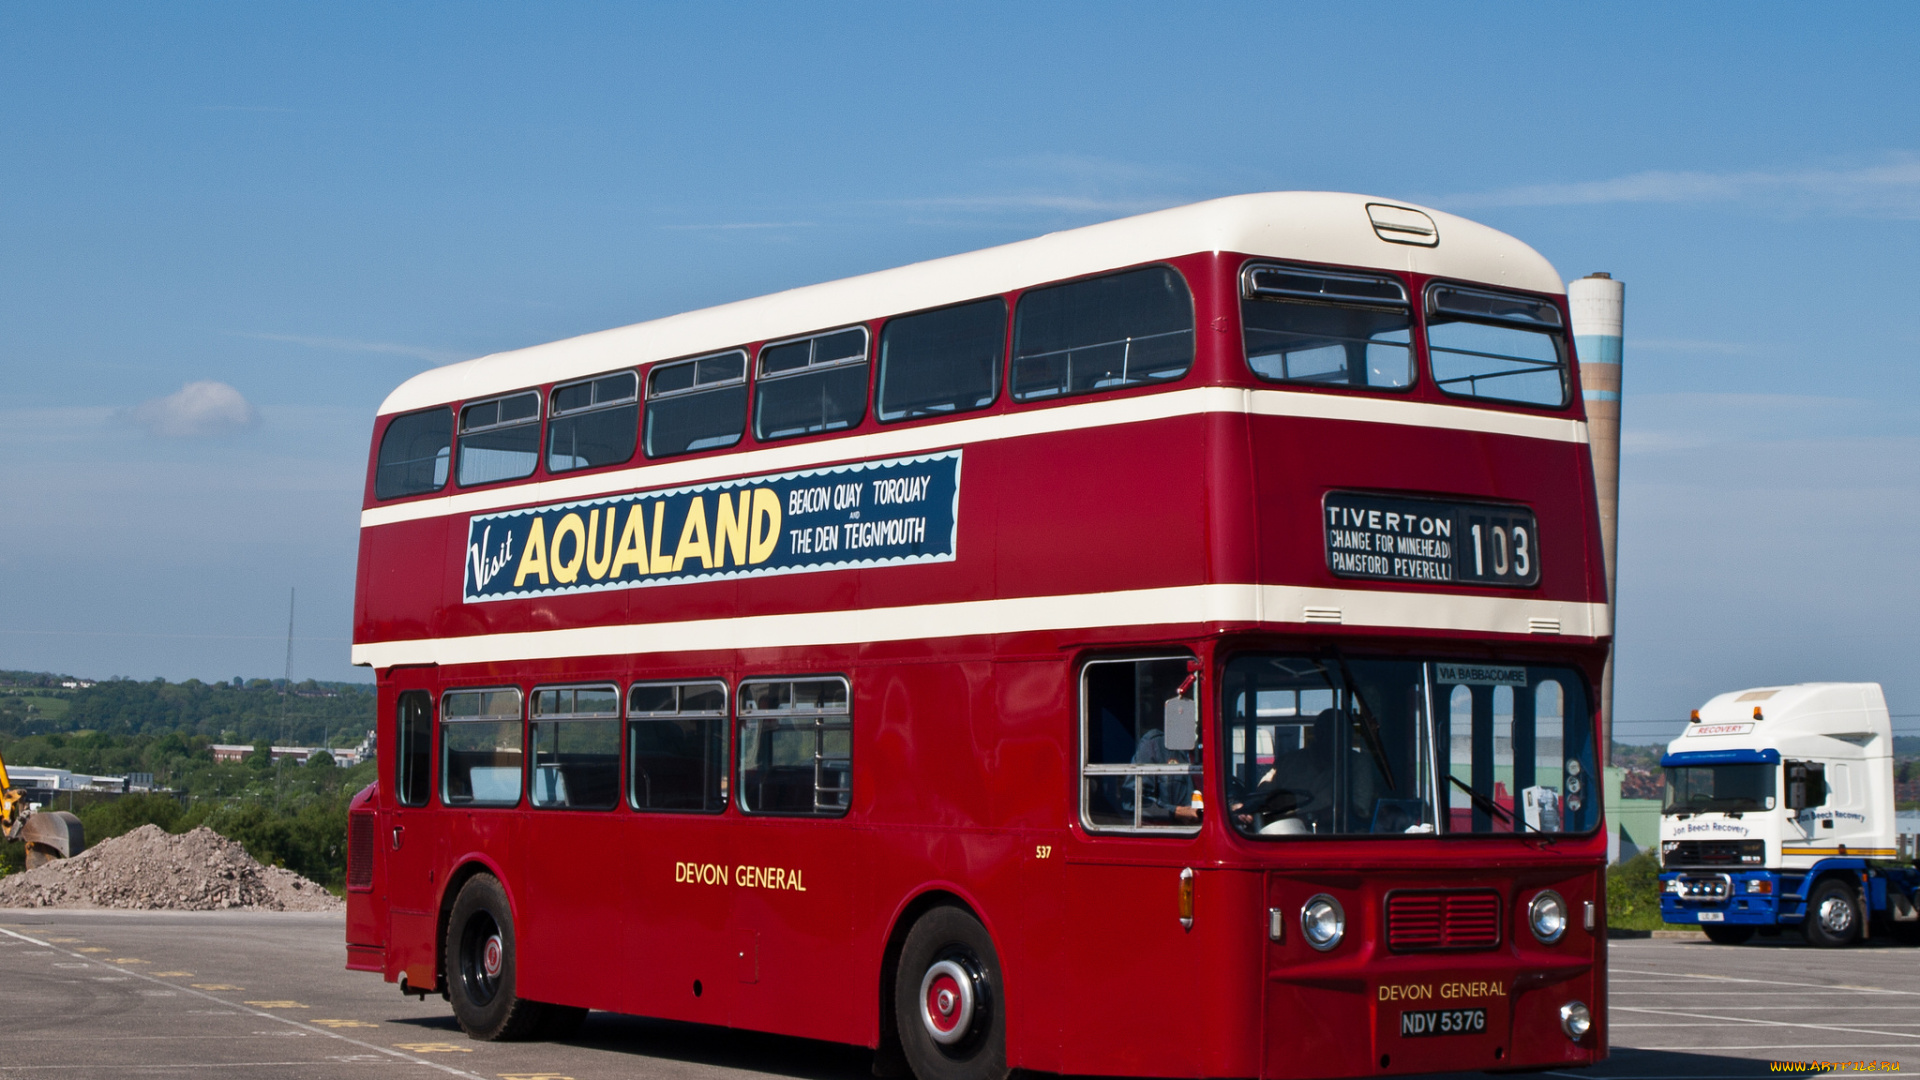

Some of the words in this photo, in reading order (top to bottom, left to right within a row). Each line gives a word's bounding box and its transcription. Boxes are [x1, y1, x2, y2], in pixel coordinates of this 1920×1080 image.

[788, 486, 831, 515] BEACON
[833, 483, 862, 511] QUAY
[873, 475, 931, 505] TORQUAY
[1326, 506, 1451, 537] TIVERTON
[514, 488, 782, 584] AQUALAND
[789, 529, 813, 555] THE
[815, 525, 838, 553] DEN
[843, 517, 926, 549] TEIGNMOUTH
[1376, 533, 1394, 553] FOR
[471, 525, 513, 592] Visit
[1472, 524, 1530, 577] 103
[1333, 551, 1389, 575] PAMSFORD
[1440, 667, 1456, 679] VIA
[1458, 668, 1525, 682] BABBACOMBE
[1699, 725, 1744, 734] RECOVERY
[1673, 827, 1685, 836] Jon
[1688, 823, 1710, 832] Beech
[1713, 822, 1750, 837] Recovery
[1036, 845, 1052, 858] 537
[675, 861, 729, 886] DEVON
[735, 865, 807, 892] GENERAL
[1378, 984, 1433, 1001] DEVON
[1440, 981, 1507, 999] GENERAL
[1402, 1012, 1437, 1034] NDV
[1440, 1010, 1485, 1031] 537G
